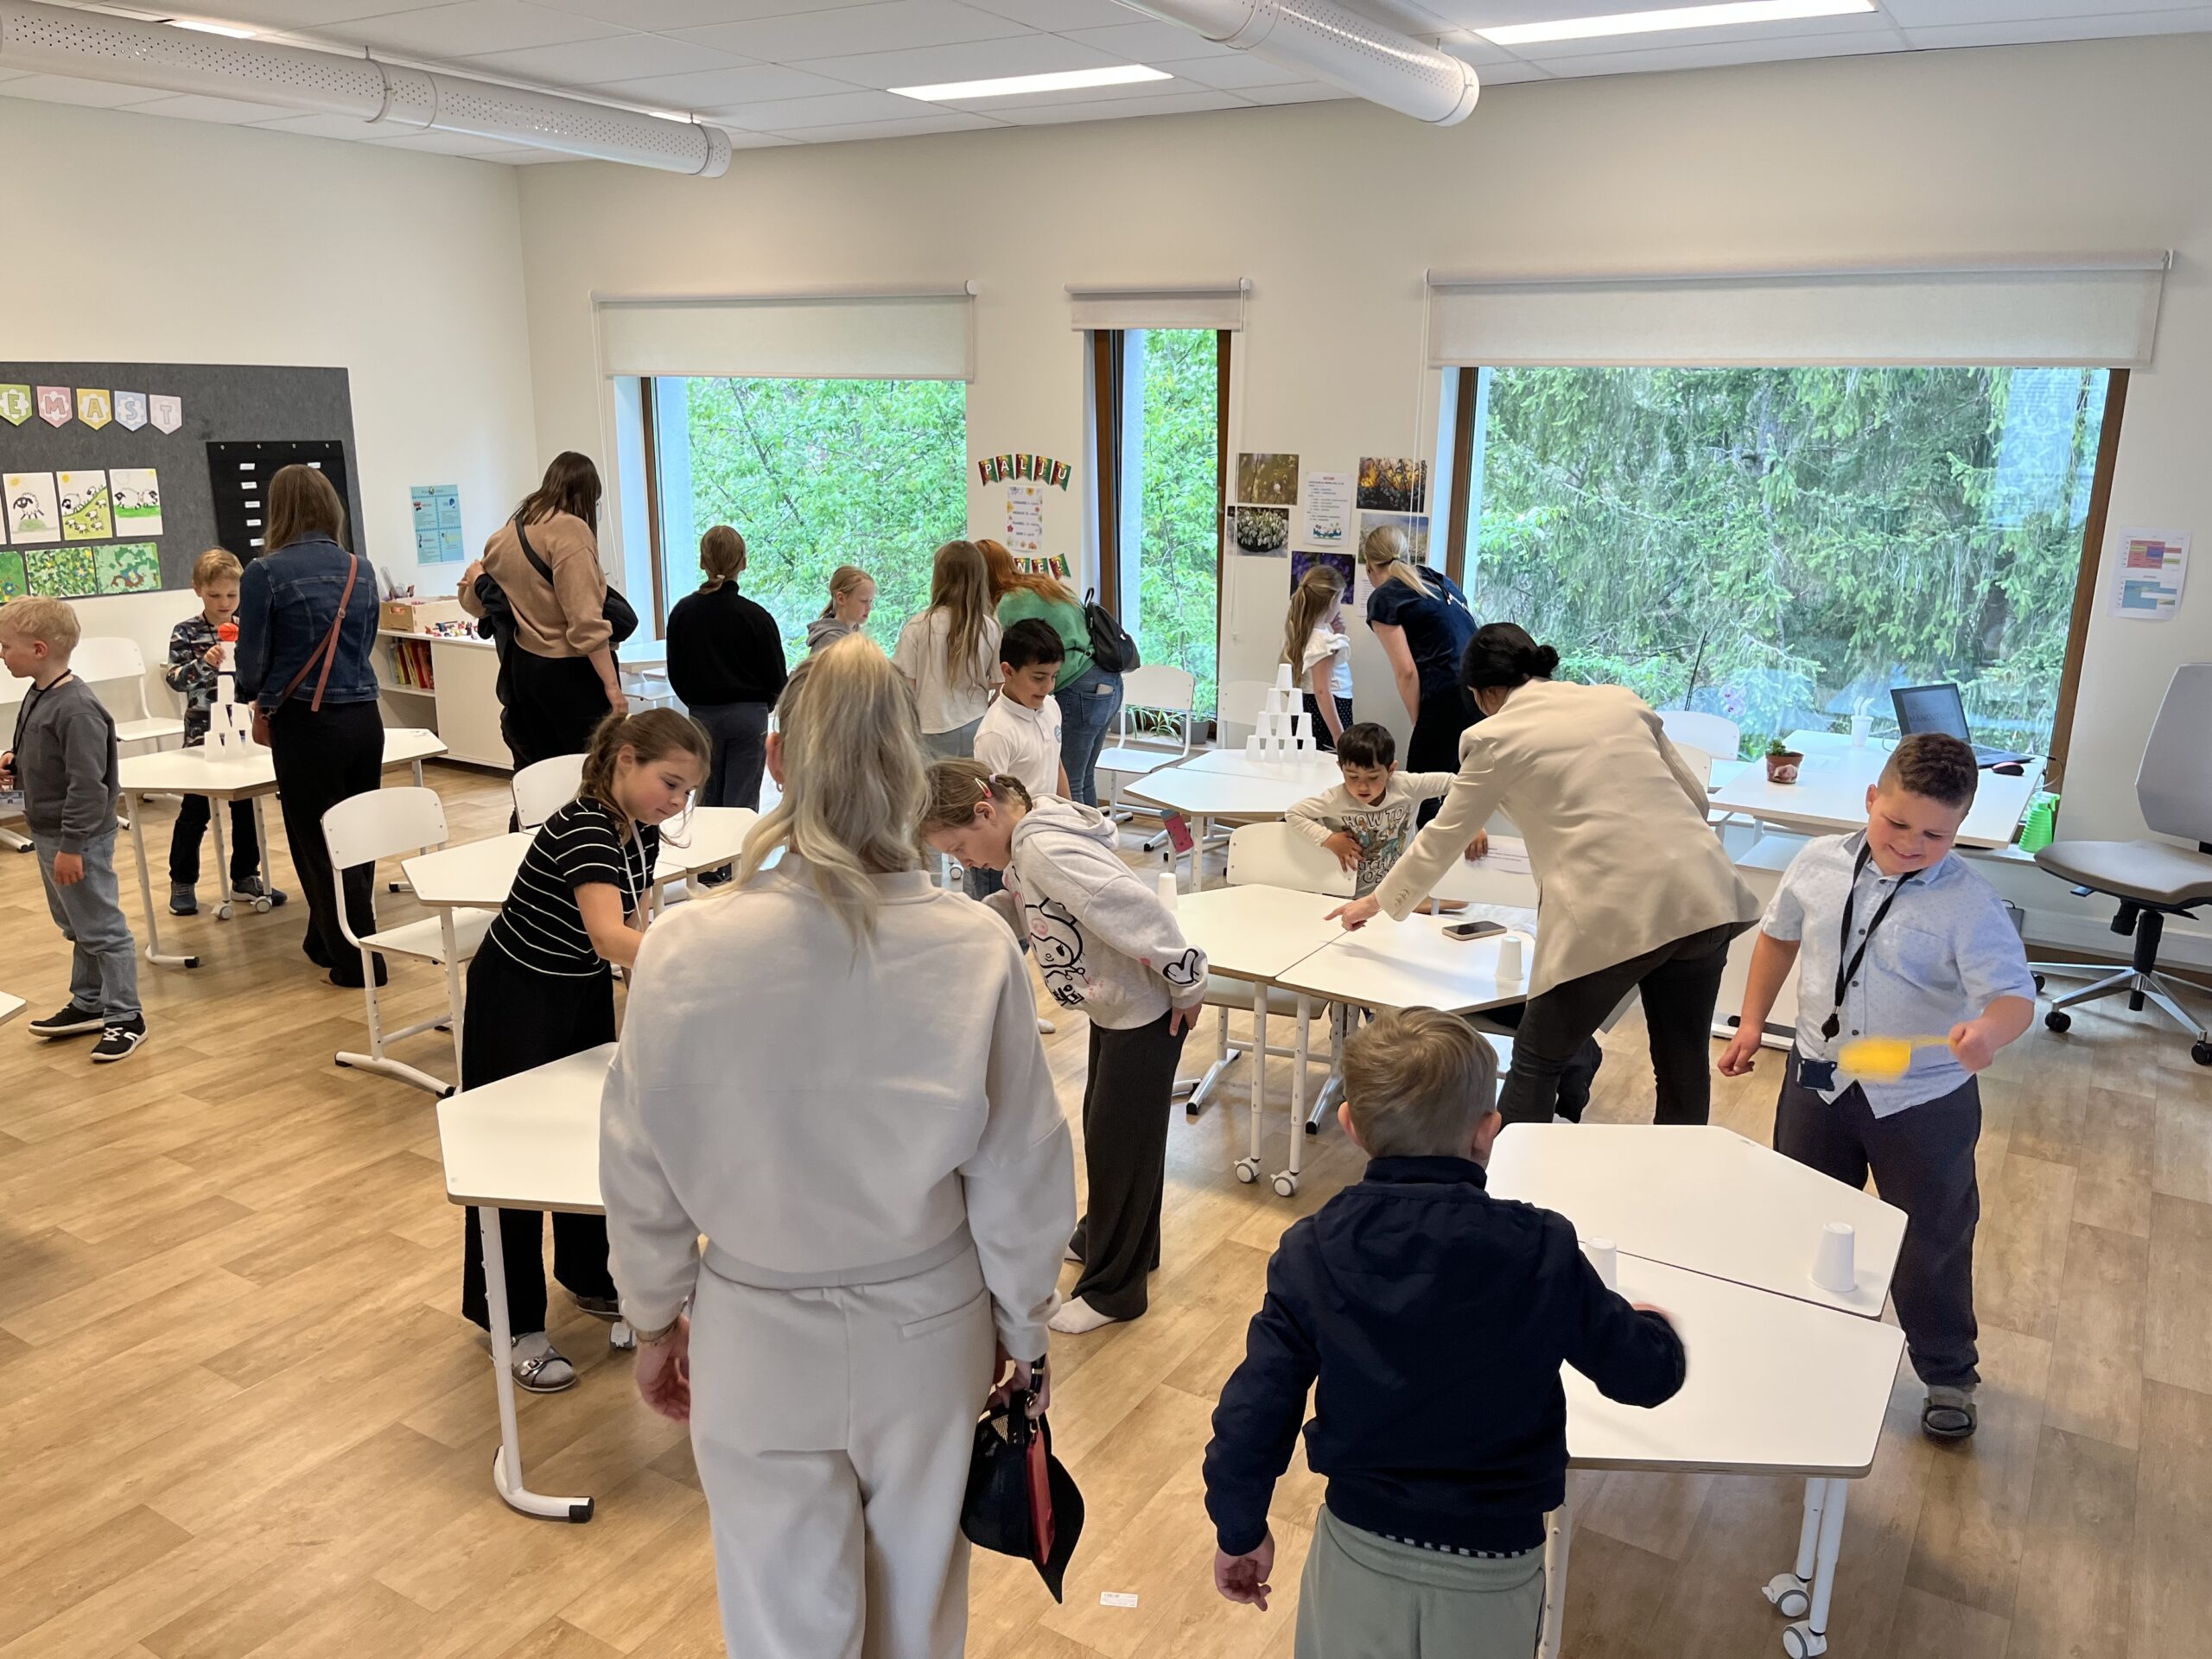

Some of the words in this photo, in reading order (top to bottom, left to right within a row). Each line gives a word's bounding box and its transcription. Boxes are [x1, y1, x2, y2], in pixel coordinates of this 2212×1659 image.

[984, 459, 1068, 480] PALJU
[1016, 560, 1062, 573] NE!
[1342, 812, 1382, 827] HOW
[1385, 807, 1404, 820] TO
